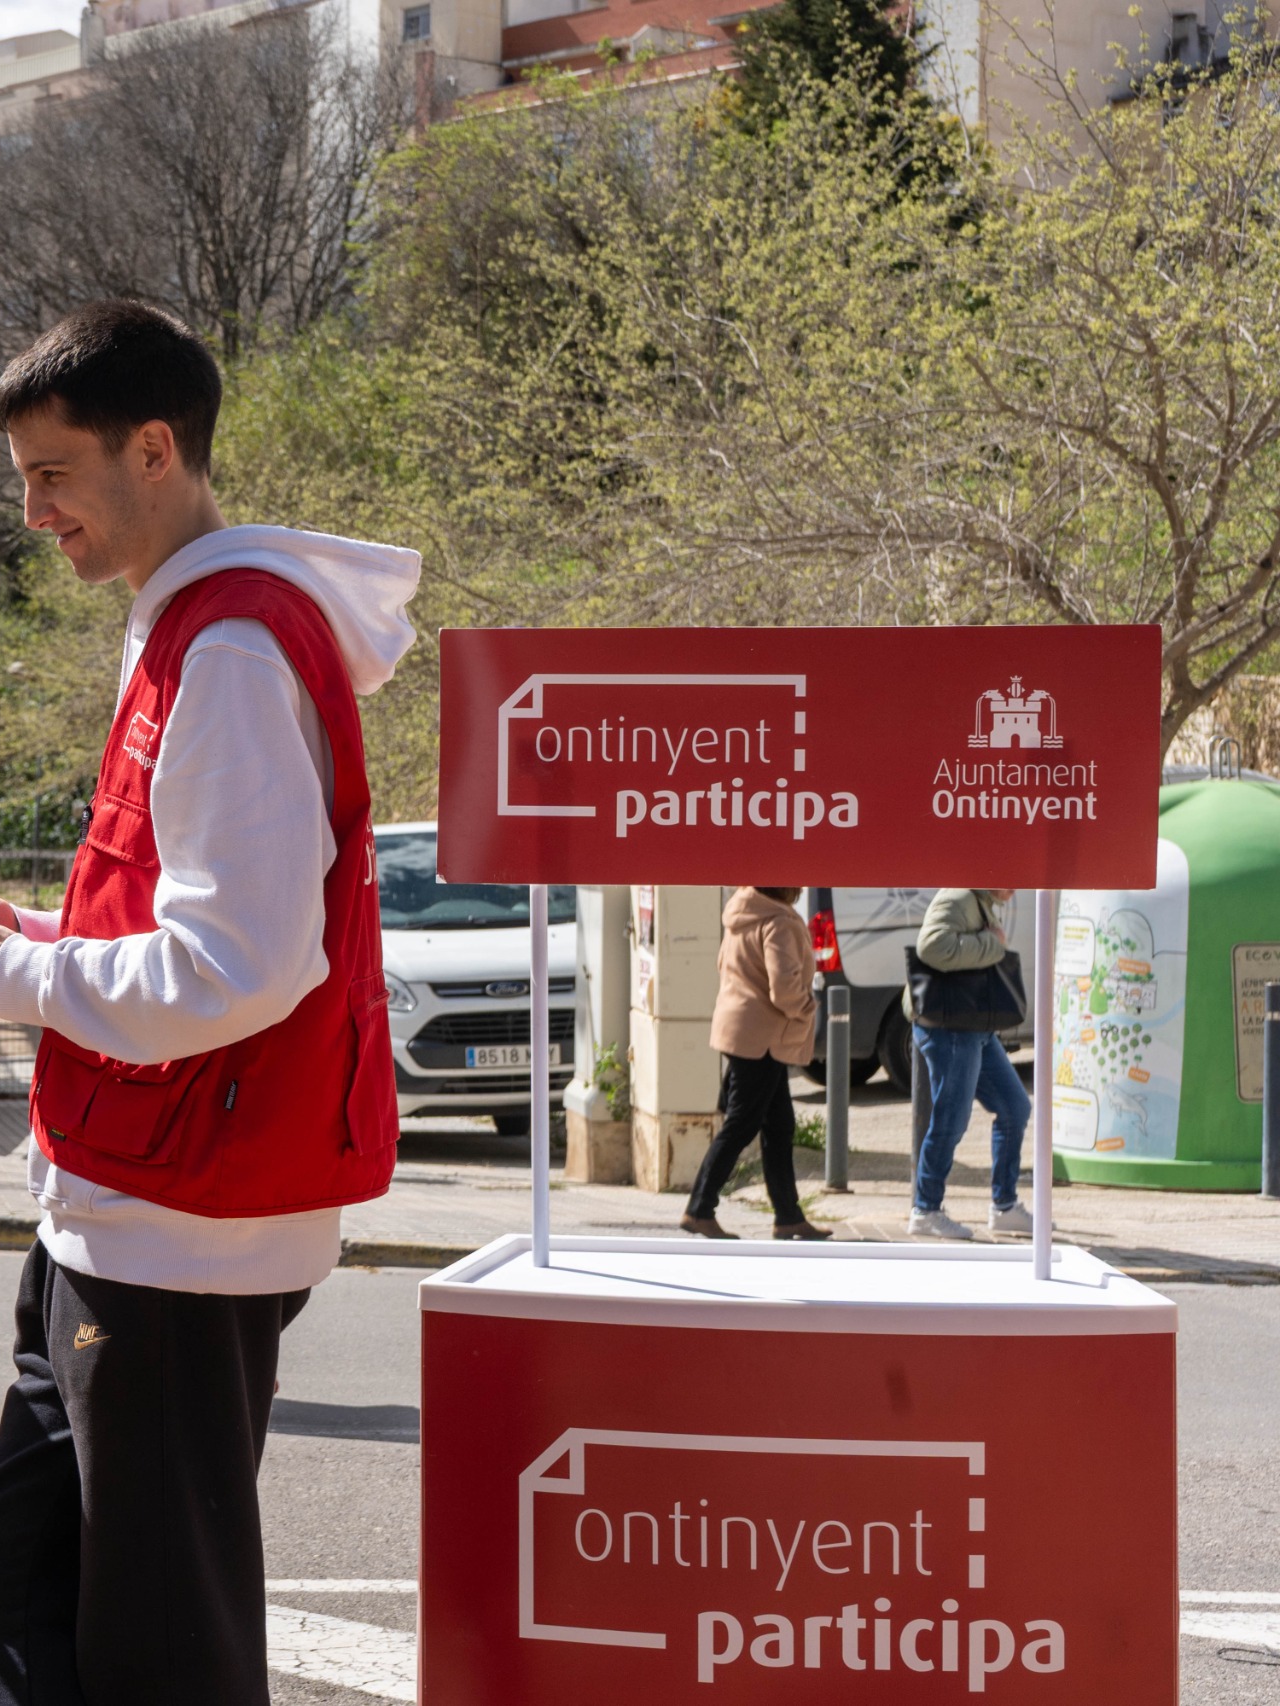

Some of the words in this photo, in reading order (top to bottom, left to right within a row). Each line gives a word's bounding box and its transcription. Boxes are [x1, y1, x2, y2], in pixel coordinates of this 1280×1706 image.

[536, 715, 771, 775] ontinyent
[933, 758, 1098, 793] Ajuntament
[616, 777, 859, 840] participa
[932, 789, 1098, 825] Ontinyent
[478, 1047, 519, 1064] 8518
[77, 1322, 100, 1340] NIKE
[575, 1498, 932, 1592] ontinyent
[697, 1597, 1065, 1693] participa
